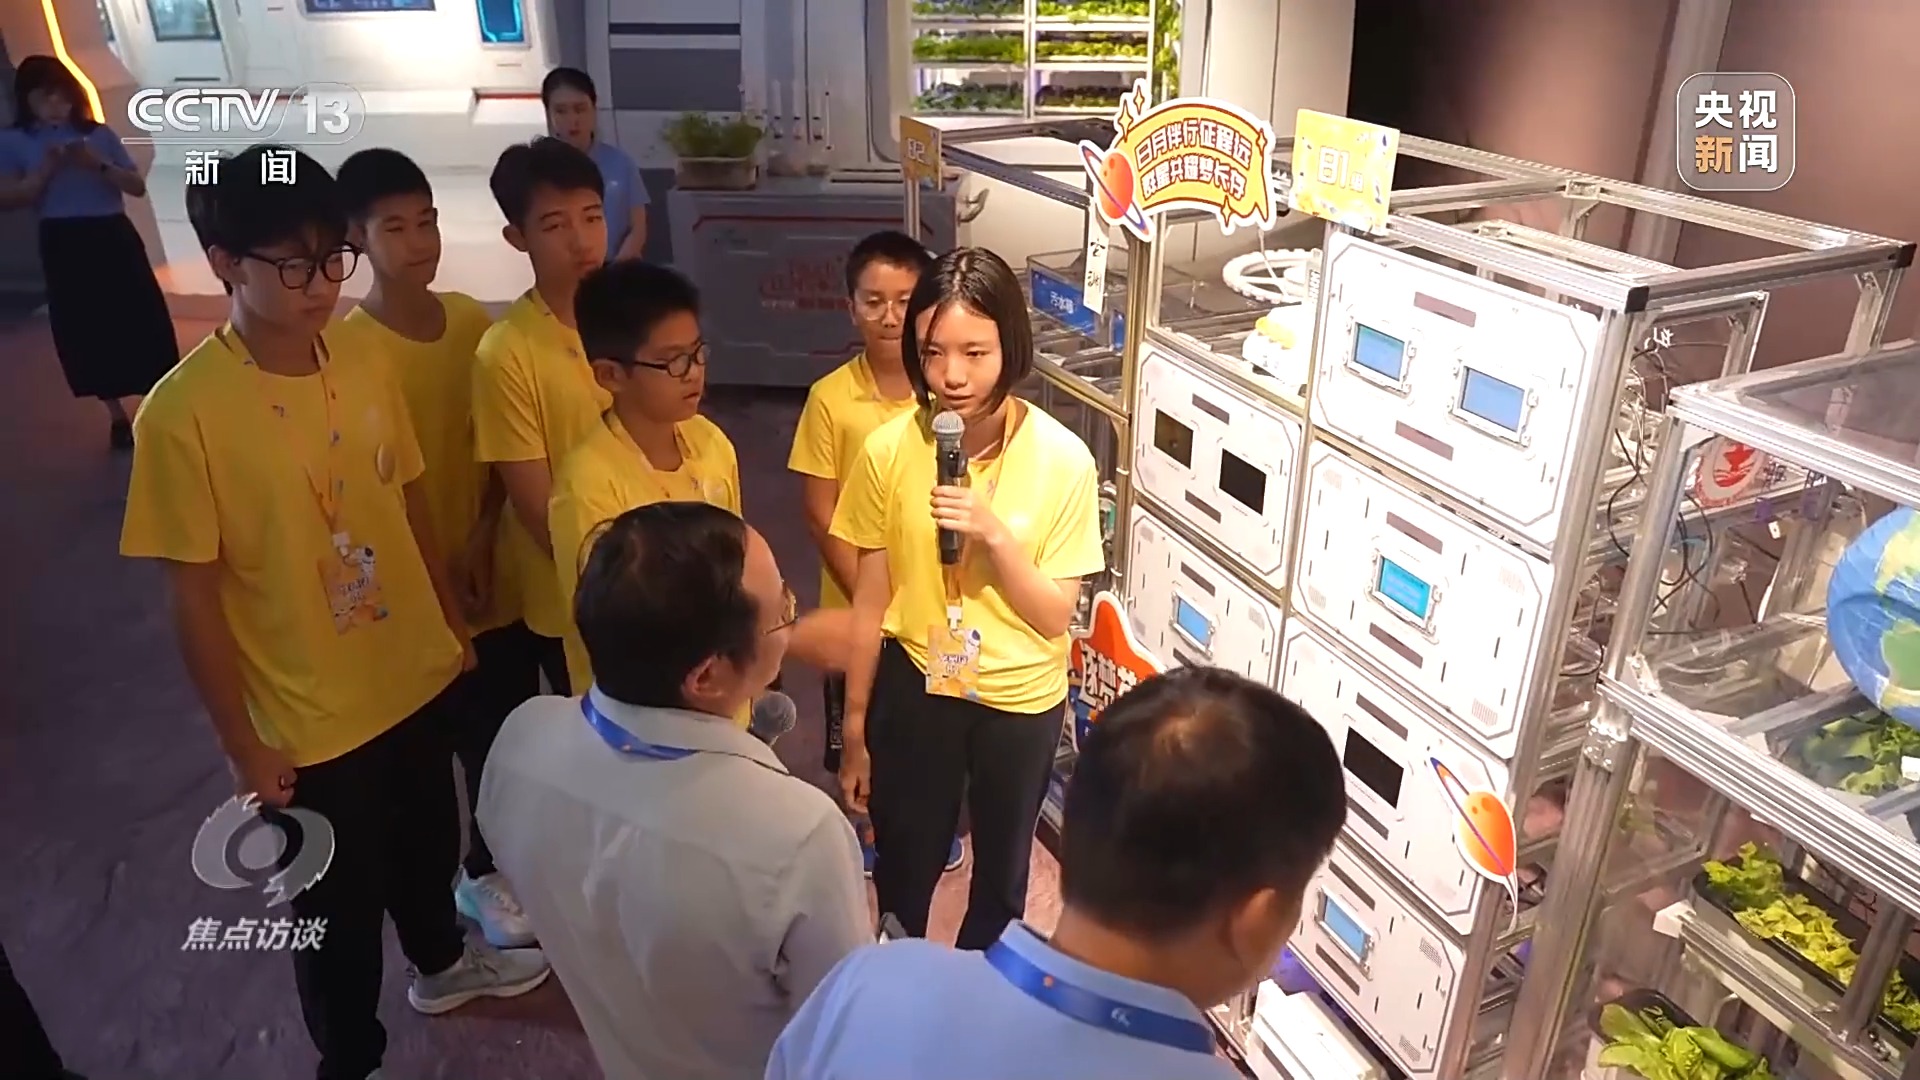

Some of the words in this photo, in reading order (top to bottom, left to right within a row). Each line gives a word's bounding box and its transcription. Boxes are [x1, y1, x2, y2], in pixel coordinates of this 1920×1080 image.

[1134, 118, 1253, 172] 日月伴行征程远
